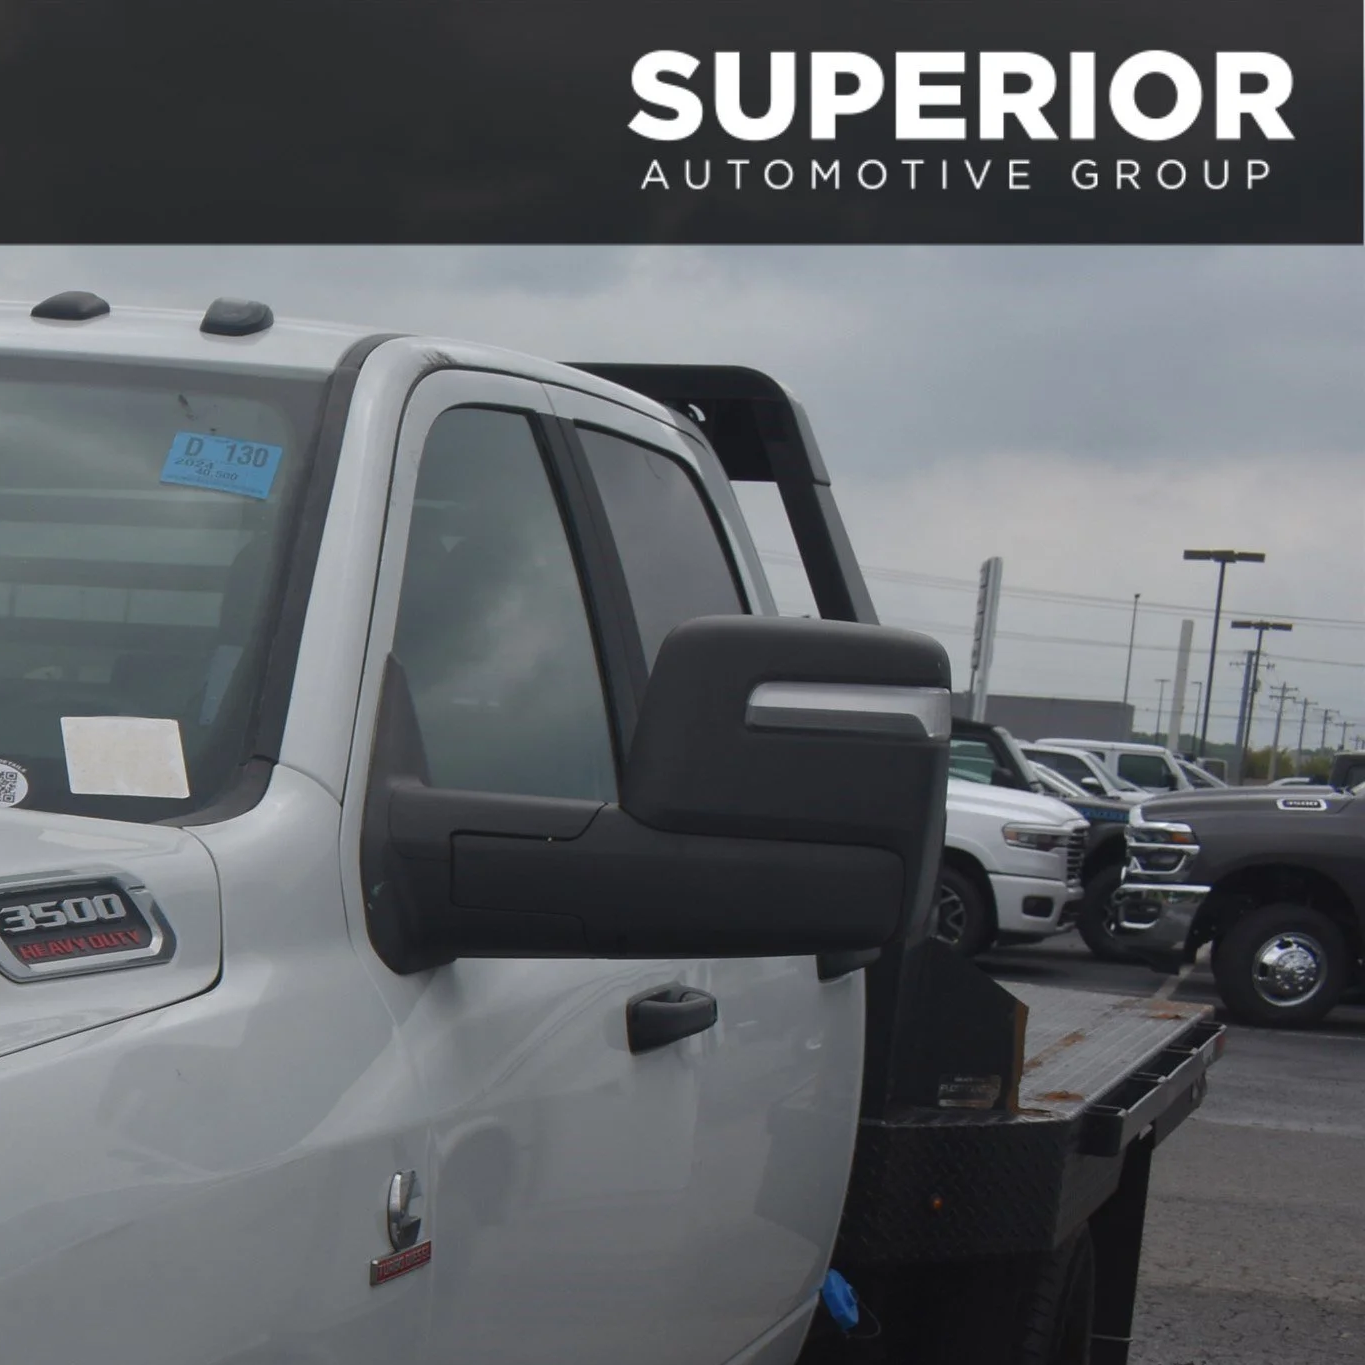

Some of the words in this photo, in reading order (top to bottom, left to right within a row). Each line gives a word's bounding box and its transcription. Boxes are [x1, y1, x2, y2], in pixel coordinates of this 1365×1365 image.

[184, 437, 205, 457] D
[226, 444, 269, 467] 130
[20, 937, 87, 959] HEAVY
[89, 930, 140, 948] DUTY
